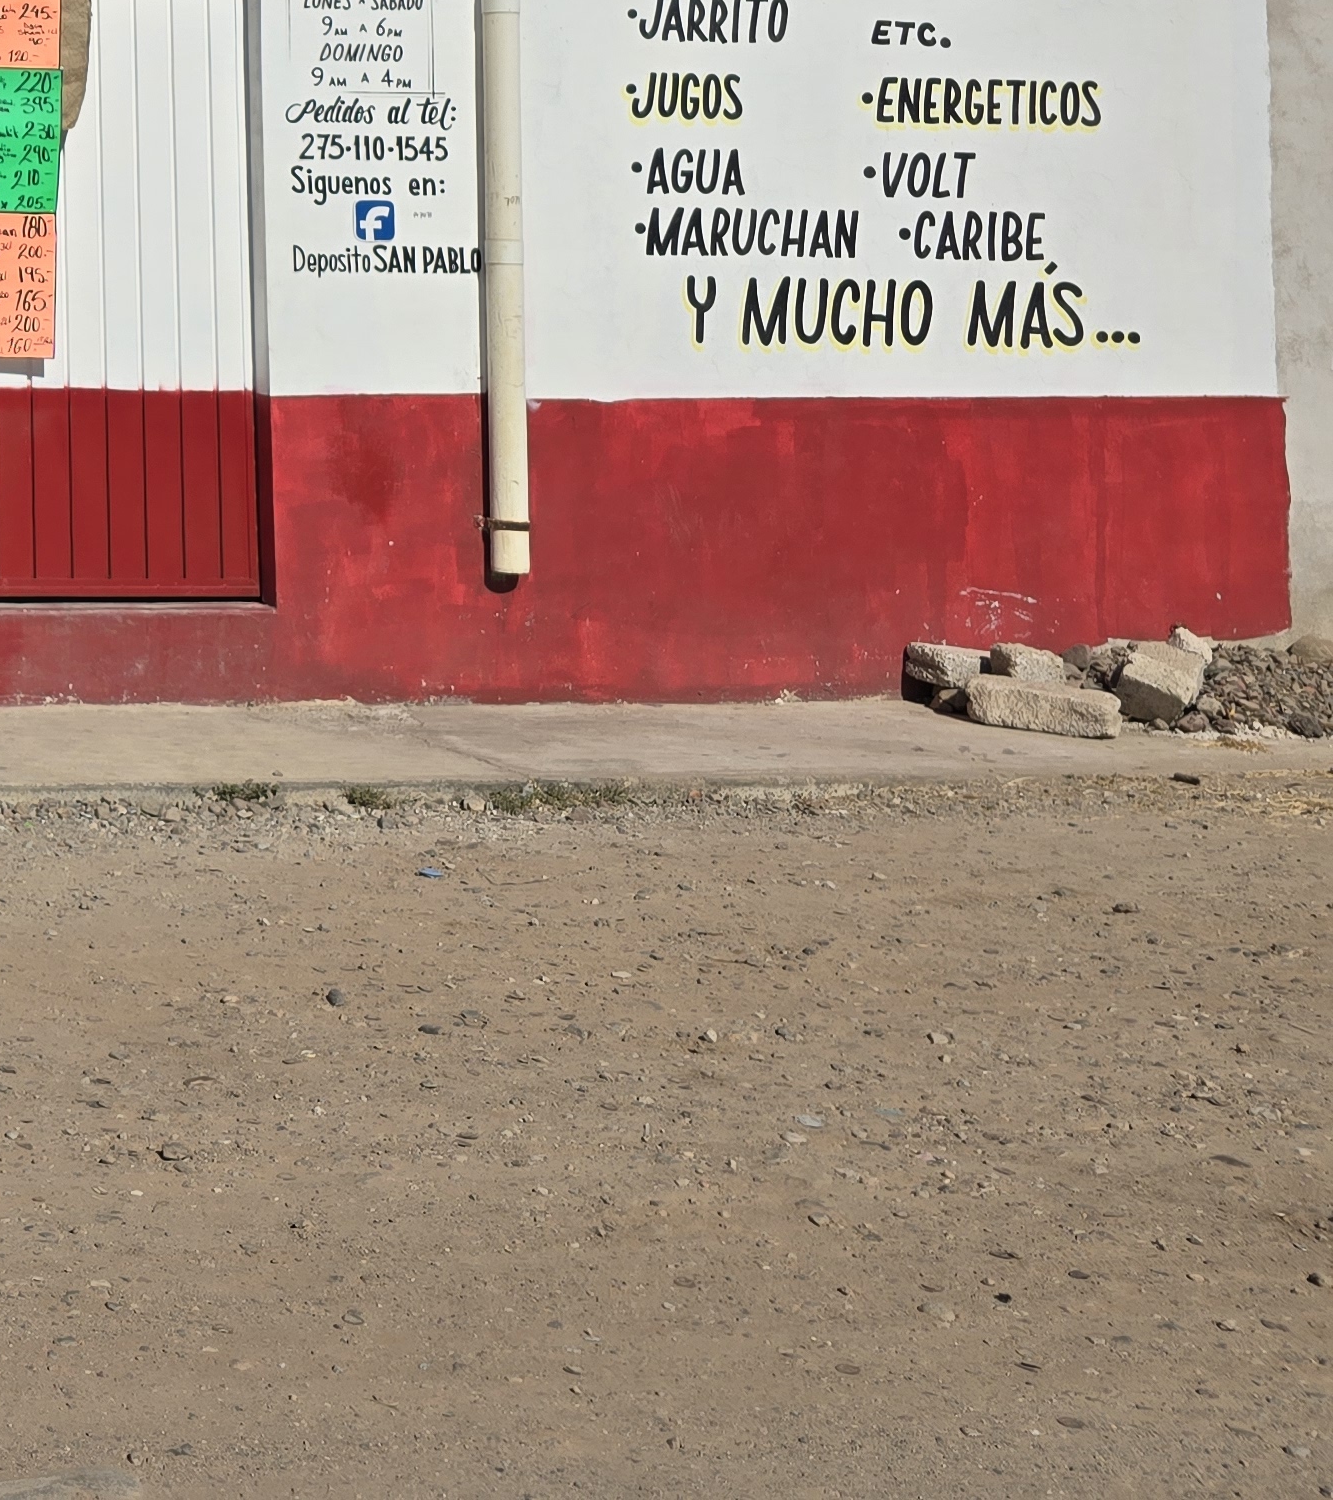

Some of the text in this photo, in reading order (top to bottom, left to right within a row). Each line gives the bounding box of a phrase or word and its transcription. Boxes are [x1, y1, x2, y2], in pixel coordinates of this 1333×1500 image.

[359, 24, 367, 33] A
[871, 20, 951, 48] ETC.
[319, 43, 403, 62] DOMINGO
[361, 73, 369, 83] A
[634, 72, 743, 120] JUGOS
[285, 96, 457, 130] Pedidos al tel:
[876, 77, 1101, 126] ENERGETICOS
[291, 166, 445, 205] Siguenos en:
[646, 148, 745, 195] AGUA
[882, 153, 976, 199] VOLT
[646, 208, 859, 258] MARUCHAN
[293, 245, 481, 278] Deposito SAN PABLO
[686, 276, 716, 344] Y
[742, 276, 933, 347] MUCHO
